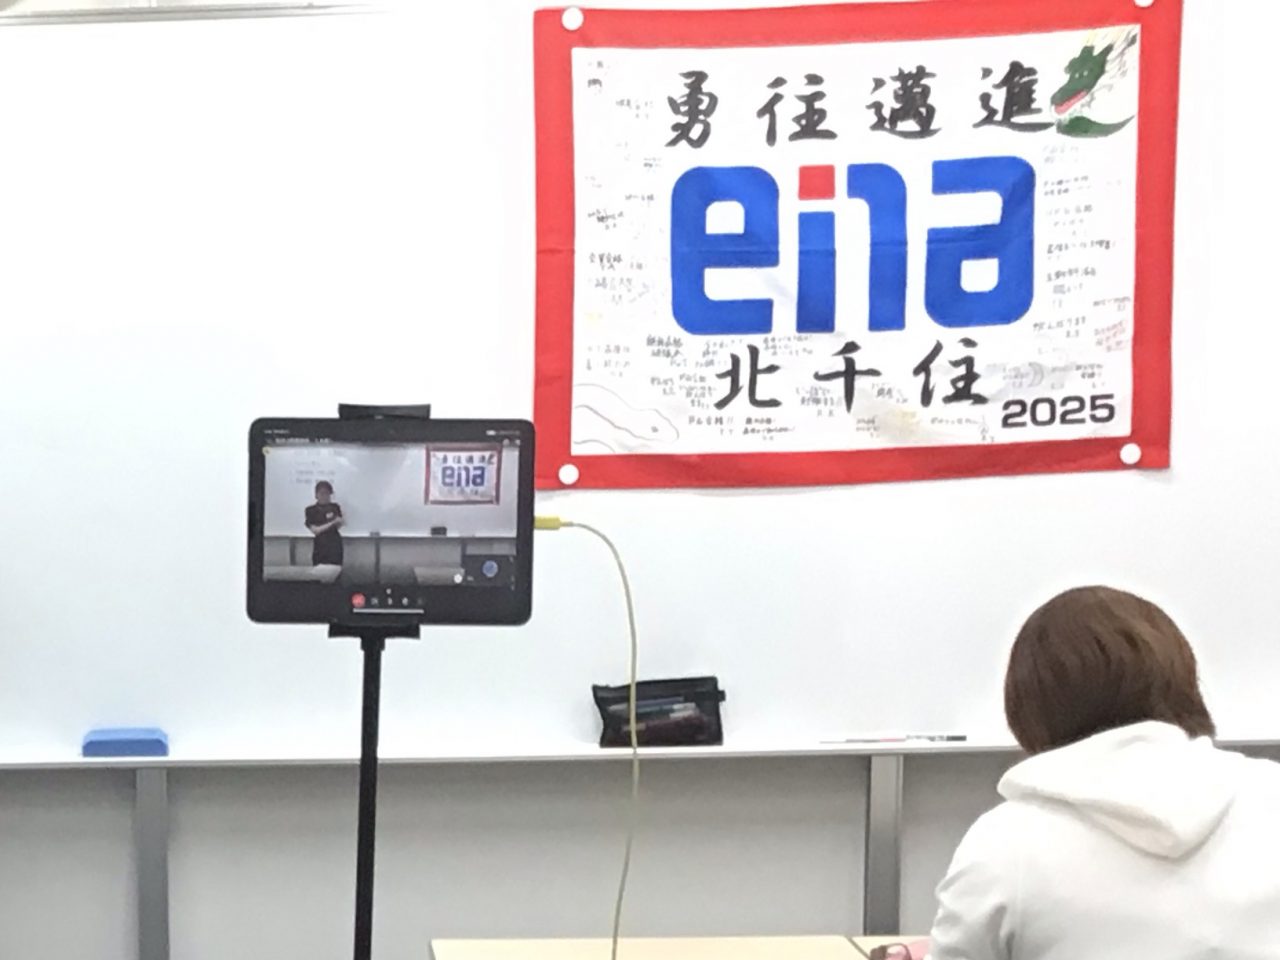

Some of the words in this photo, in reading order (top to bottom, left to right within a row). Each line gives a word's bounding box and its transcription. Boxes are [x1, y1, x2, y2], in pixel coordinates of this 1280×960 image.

[665, 61, 1056, 148] 勇往邁進
[671, 155, 1036, 336] ena
[715, 338, 990, 413] 北千住
[1001, 394, 1116, 430] 2025
[441, 465, 486, 487] ena
